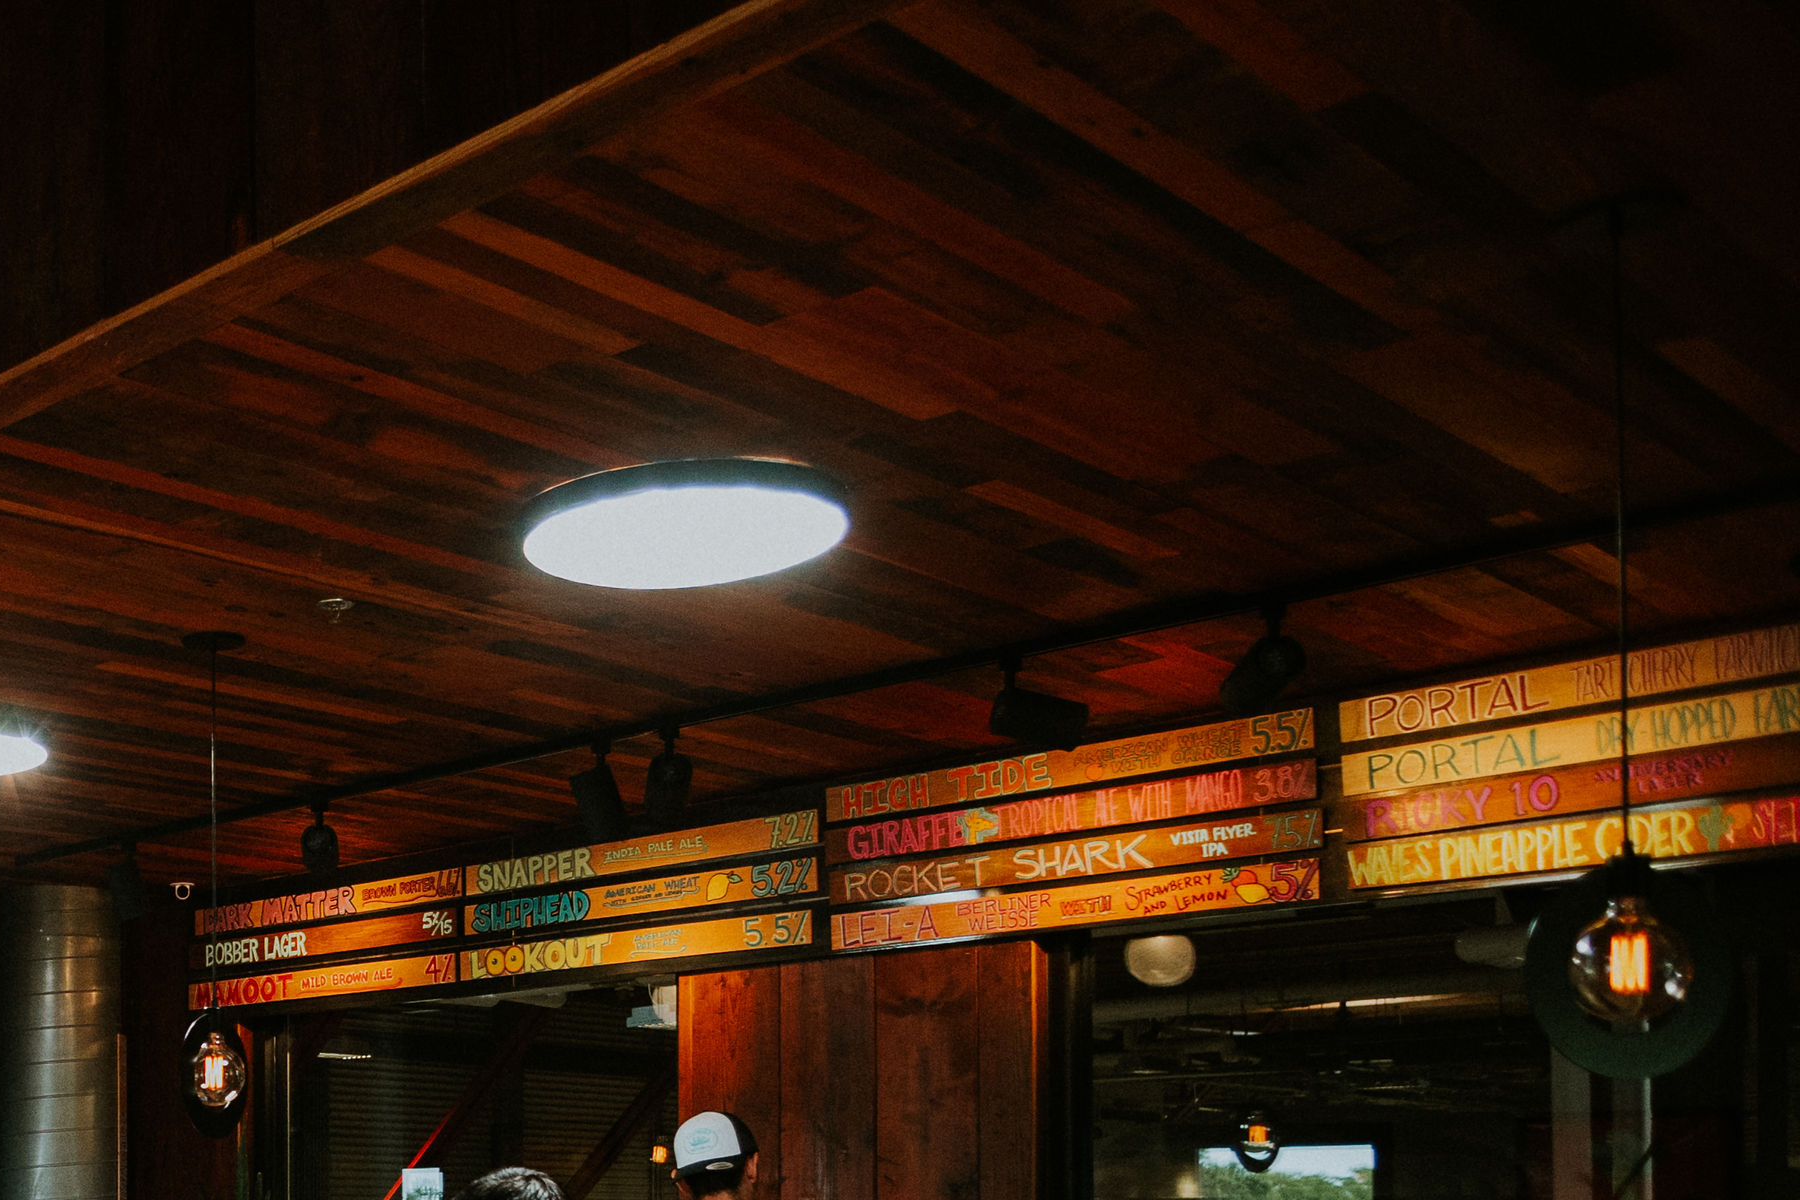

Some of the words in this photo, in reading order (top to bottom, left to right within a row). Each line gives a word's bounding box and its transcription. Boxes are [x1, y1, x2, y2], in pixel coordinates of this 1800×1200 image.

[1367, 675, 1550, 737] PORTAL
[1570, 658, 1616, 700] TART
[1628, 645, 1698, 693] CHERRY
[1073, 737, 1168, 767] AMERICAN
[1176, 722, 1247, 748] WHEAT
[1250, 708, 1313, 754] 5.5%
[1368, 729, 1560, 790] PORTAL
[1754, 687, 1800, 733] FAR
[1111, 752, 1161, 773] WITH
[1171, 741, 1242, 764] ORANGE
[842, 773, 930, 820] HIGH
[948, 752, 1052, 802] TIDE
[848, 809, 967, 860] GIRAFFE
[992, 793, 1082, 840] TROPICAL
[1094, 786, 1121, 826] ALE
[1128, 781, 1172, 822] WITH
[1186, 768, 1243, 813] MANGO
[1253, 762, 1313, 802] 3.8%
[1365, 786, 1492, 838] RICKY
[1511, 775, 1560, 816] 10
[604, 846, 640, 860] INDIA
[647, 839, 673, 853] PALE
[679, 835, 703, 849] ALE
[764, 810, 815, 850] 7.2%
[1170, 829, 1209, 846] VISTA
[1212, 822, 1257, 841] FLYER
[1201, 841, 1229, 858] IPA
[1348, 841, 1433, 886] WAVES
[1439, 821, 1589, 880] PINEAPPLE
[1595, 811, 1695, 860] CDER
[477, 847, 596, 893] SNAPPER
[751, 857, 811, 897] 5.2%
[844, 855, 991, 900] ROCKET
[1012, 833, 1154, 879] SHARK
[1269, 858, 1319, 902] 5%
[261, 886, 357, 927] MATTER
[362, 883, 396, 899] BROWN
[399, 876, 435, 894] PORTER
[605, 883, 656, 899] AMERICAN
[664, 876, 700, 890] WHEAT
[955, 892, 1052, 917] BERLINER
[1060, 894, 1112, 916] WITH
[1125, 873, 1212, 911] STRAWBERRY
[1143, 900, 1167, 915] AND
[1176, 889, 1228, 910] LEMON
[472, 890, 590, 933] SHIPHEAD
[743, 911, 808, 947] 5.5%
[840, 905, 939, 947] LEI-A
[968, 909, 1041, 932] WEISSE
[205, 938, 259, 967] BOBBER
[264, 931, 307, 960] LAGER
[470, 933, 612, 979] LOOKOUT
[301, 974, 327, 990] MILD
[333, 970, 369, 986] BROWN
[374, 967, 393, 980] ALE
[425, 954, 453, 983] 4%
